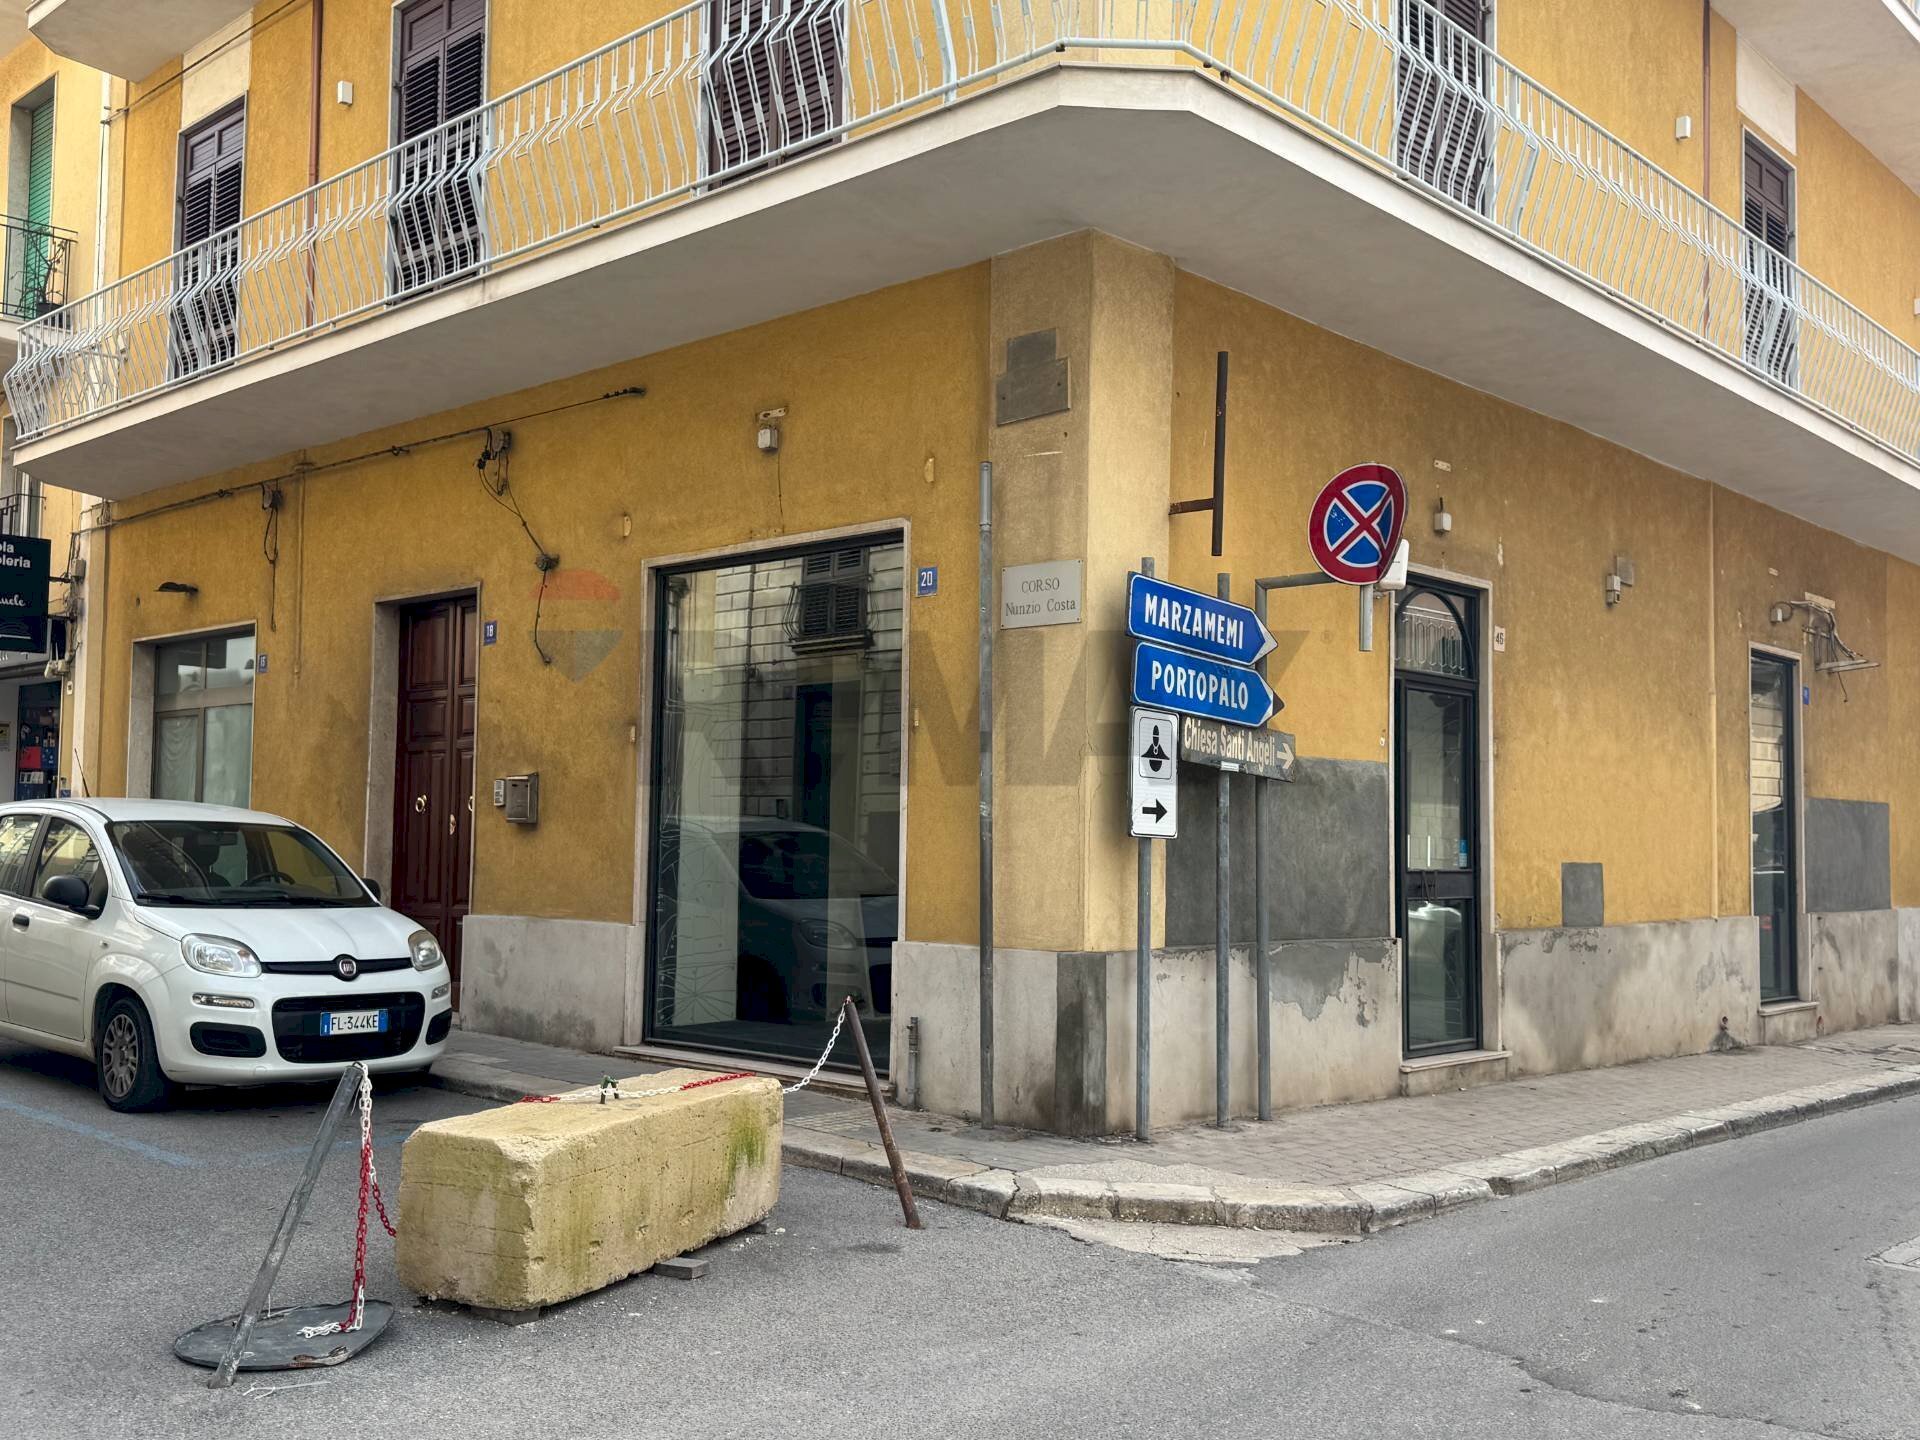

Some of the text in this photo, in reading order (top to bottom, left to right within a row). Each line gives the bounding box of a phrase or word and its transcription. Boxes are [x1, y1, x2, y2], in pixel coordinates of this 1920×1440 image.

[920, 571, 933, 587] 20
[1021, 577, 1060, 593] CORSO
[1005, 598, 1077, 617] Nunzio Costa
[486, 624, 494, 638] 18
[1144, 593, 1244, 650] MARZAMEMI
[1151, 660, 1249, 711] PORTOPALO
[1184, 716, 1275, 773] Chiesa Santi Angeli
